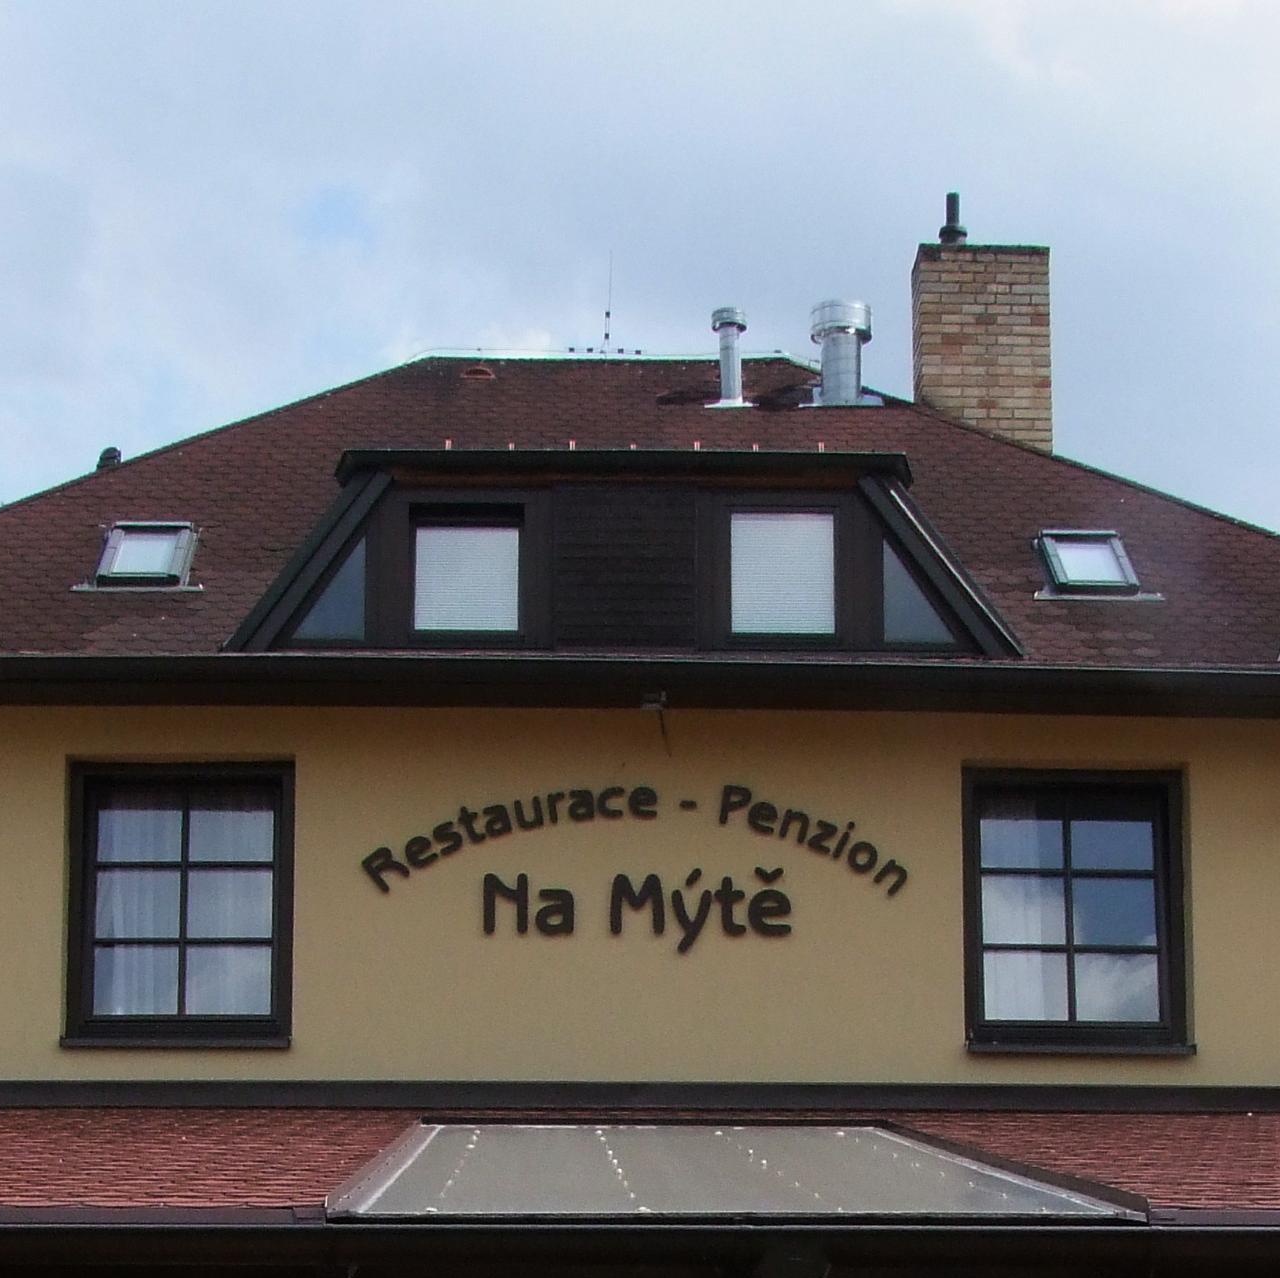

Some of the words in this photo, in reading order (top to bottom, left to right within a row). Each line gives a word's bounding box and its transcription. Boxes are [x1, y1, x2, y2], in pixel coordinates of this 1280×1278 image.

[360, 785, 659, 895] Restaurace
[717, 783, 909, 897] Penzion
[482, 872, 575, 937] Na
[609, 866, 793, 955] Mýtě
